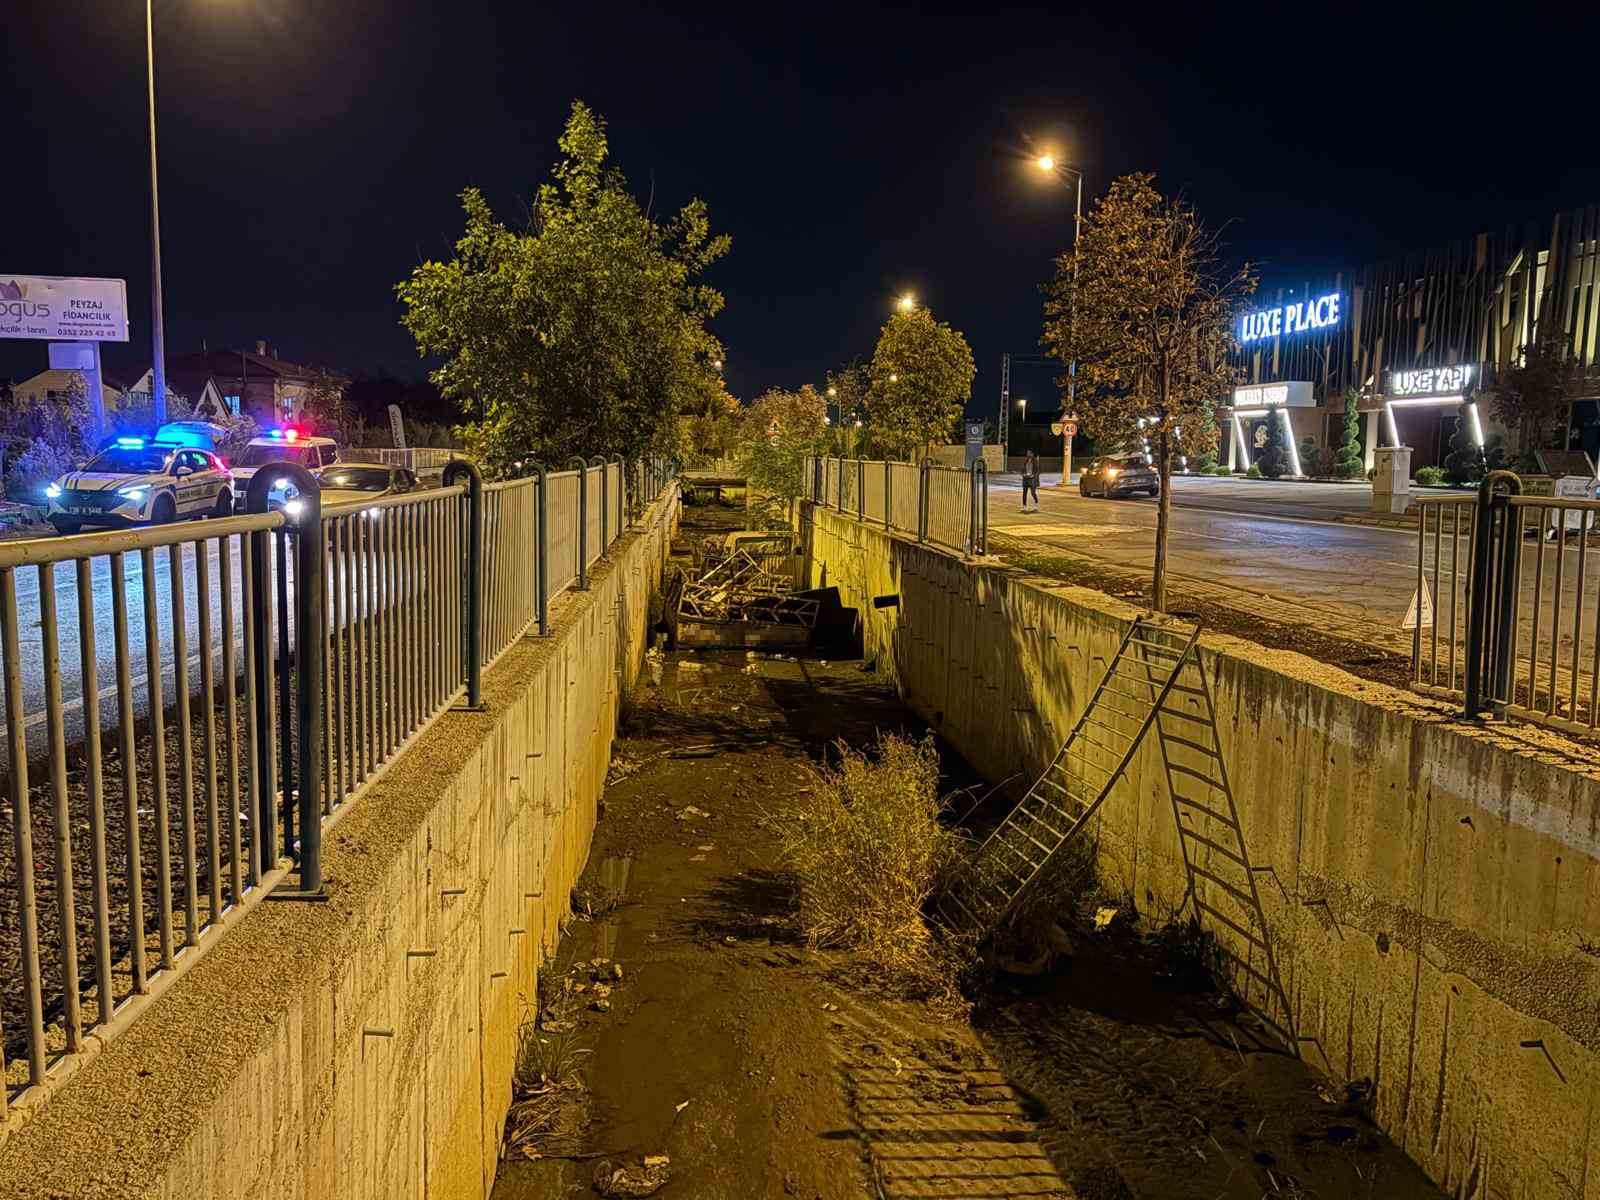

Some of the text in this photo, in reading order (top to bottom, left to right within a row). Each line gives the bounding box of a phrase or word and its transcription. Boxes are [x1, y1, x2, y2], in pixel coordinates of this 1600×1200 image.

[70, 300, 103, 309] PEYZAJ
[1241, 293, 1340, 341] LUXE PLACE
